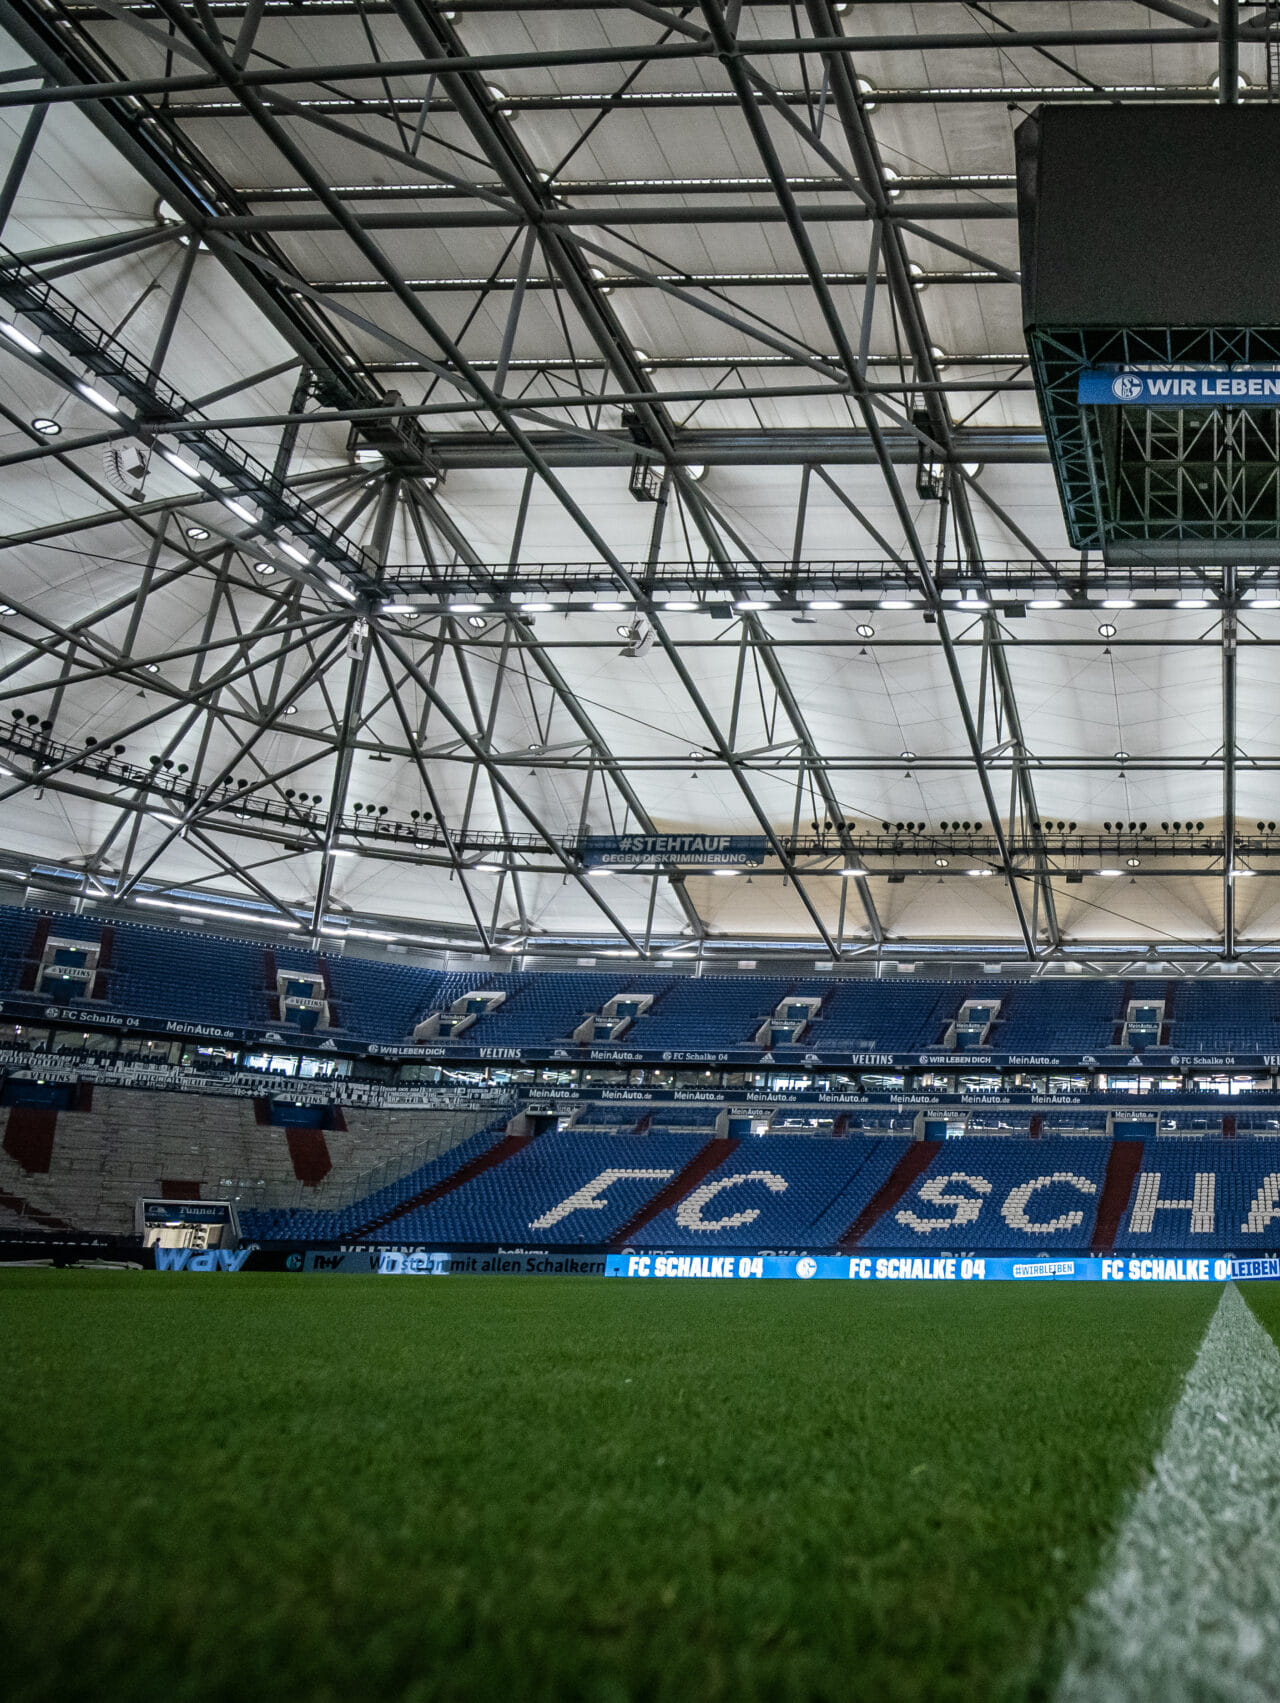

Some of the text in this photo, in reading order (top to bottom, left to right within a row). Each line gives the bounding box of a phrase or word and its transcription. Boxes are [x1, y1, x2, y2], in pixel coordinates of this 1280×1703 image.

[1147, 379, 1197, 396] WIR
[619, 837, 731, 852] #STEHTAUF
[602, 853, 746, 864] GEGEN DISKRIMINIERUNG
[58, 967, 90, 977] VELTINS
[61, 1010, 140, 1027] FC Schalke 04
[166, 1020, 235, 1038] MeinAuto.de
[380, 1045, 446, 1056] WIR LEBEN DICH
[479, 1047, 522, 1059] VELTINS
[591, 1051, 643, 1061] MeinAuto.de
[673, 1052, 729, 1062] FC Schalke 04
[852, 1054, 894, 1065] VELTINS
[929, 1055, 991, 1064] WIR LEBEN DICH
[1008, 1055, 1060, 1065] MeinAuto.de
[1181, 1056, 1235, 1065] FC Schalke 04
[30, 1071, 71, 1081] VELTINS
[529, 1089, 580, 1099] MeinAuto.de
[601, 1090, 653, 1100] MeinAuto.de
[674, 1091, 725, 1101] MeinAuto.de
[746, 1092, 797, 1102] MeinAuto.de
[818, 1093, 869, 1103] MeinAuto.de
[890, 1094, 940, 1104] MeinAuto.de
[961, 1095, 1011, 1104] MeinAuto.de
[1031, 1095, 1081, 1104] MeinAuto.de
[927, 1110, 967, 1118] MeinAuto.de
[1115, 1111, 1155, 1119] MeinAuto.de
[180, 1206, 216, 1215] Tunnel
[217, 1206, 225, 1215] 2
[369, 1255, 398, 1271] Wir
[450, 1256, 478, 1272] mit
[481, 1256, 521, 1272] allen
[526, 1257, 605, 1273] Schalkern
[628, 1256, 764, 1278] FC SCHALKE 04
[849, 1258, 986, 1279] FC SCHALKE 04
[1015, 1263, 1073, 1276] #WIRBLEIBEN
[1102, 1259, 1124, 1280] FC
[1128, 1259, 1209, 1280] SCHALKE
